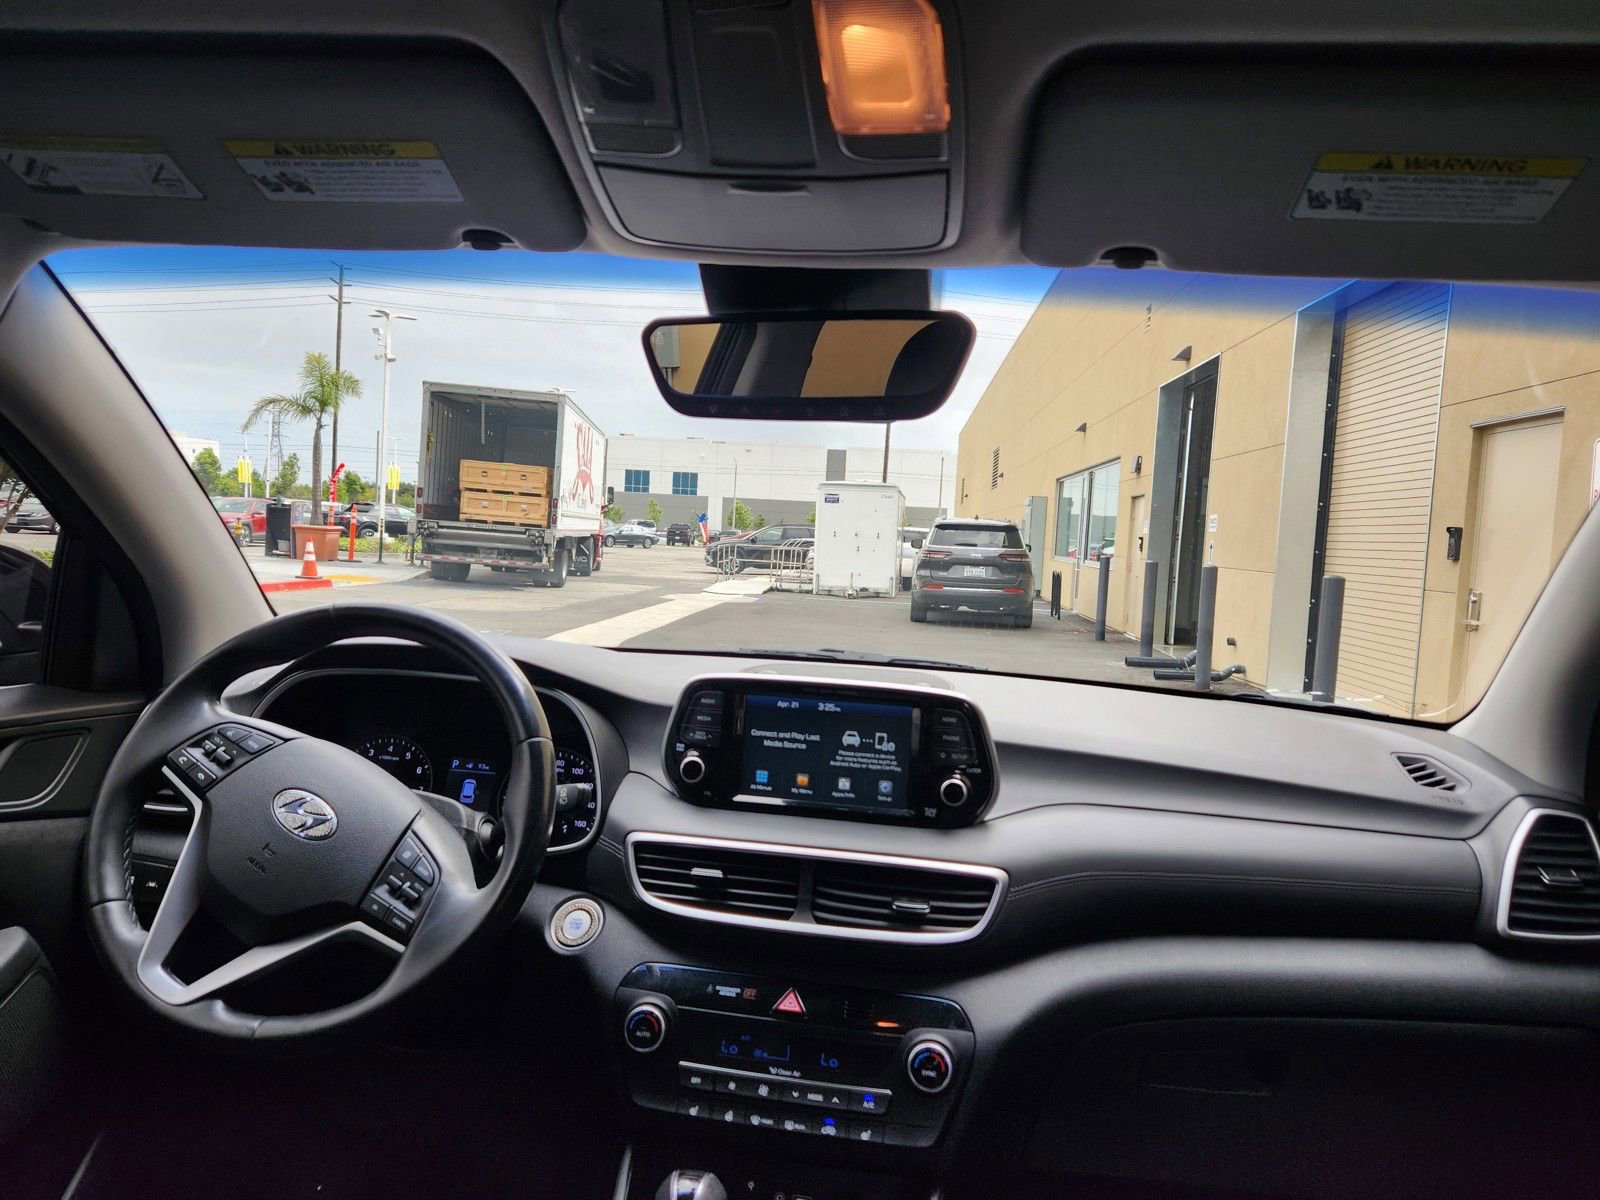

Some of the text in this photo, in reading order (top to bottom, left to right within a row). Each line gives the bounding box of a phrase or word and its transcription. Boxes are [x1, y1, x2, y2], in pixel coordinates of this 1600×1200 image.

[1404, 156, 1528, 173] WARNING
[776, 700, 800, 709] Apr 21
[751, 729, 778, 738] Connect
[791, 732, 805, 741] Play
[805, 733, 820, 741] Last
[763, 739, 807, 750] Media Source
[405, 752, 412, 760] 5
[452, 759, 460, 769] P
[416, 766, 423, 774] 6
[571, 767, 584, 775] 100
[574, 820, 587, 828] 160
